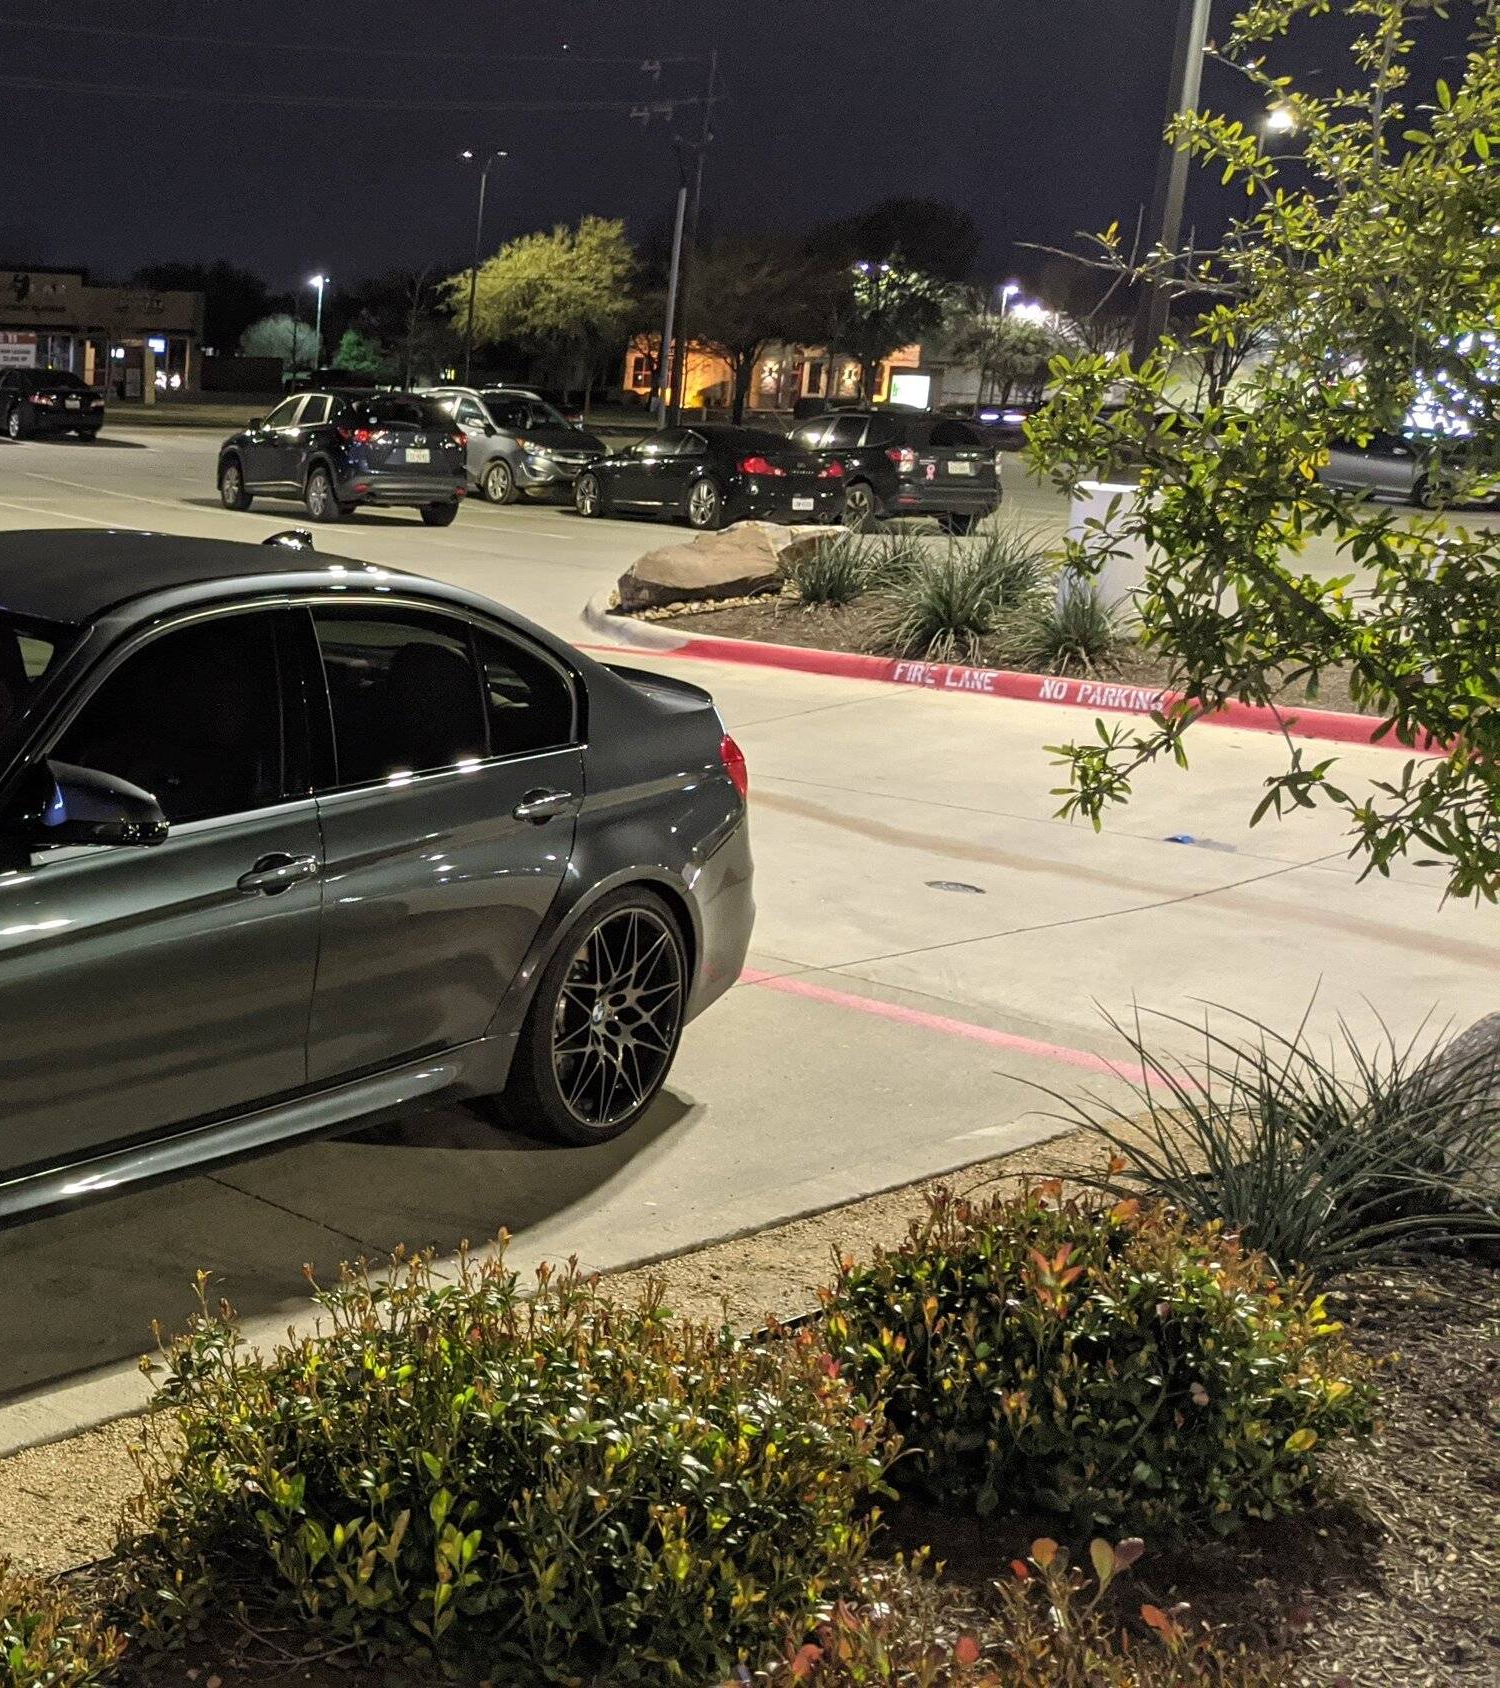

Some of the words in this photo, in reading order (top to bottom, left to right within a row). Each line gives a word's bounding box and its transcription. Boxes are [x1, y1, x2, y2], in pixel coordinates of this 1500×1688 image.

[893, 662, 939, 684] FIRE
[944, 667, 998, 691] LANE
[1038, 678, 1068, 700] NO
[1076, 684, 1164, 711] PARKING
